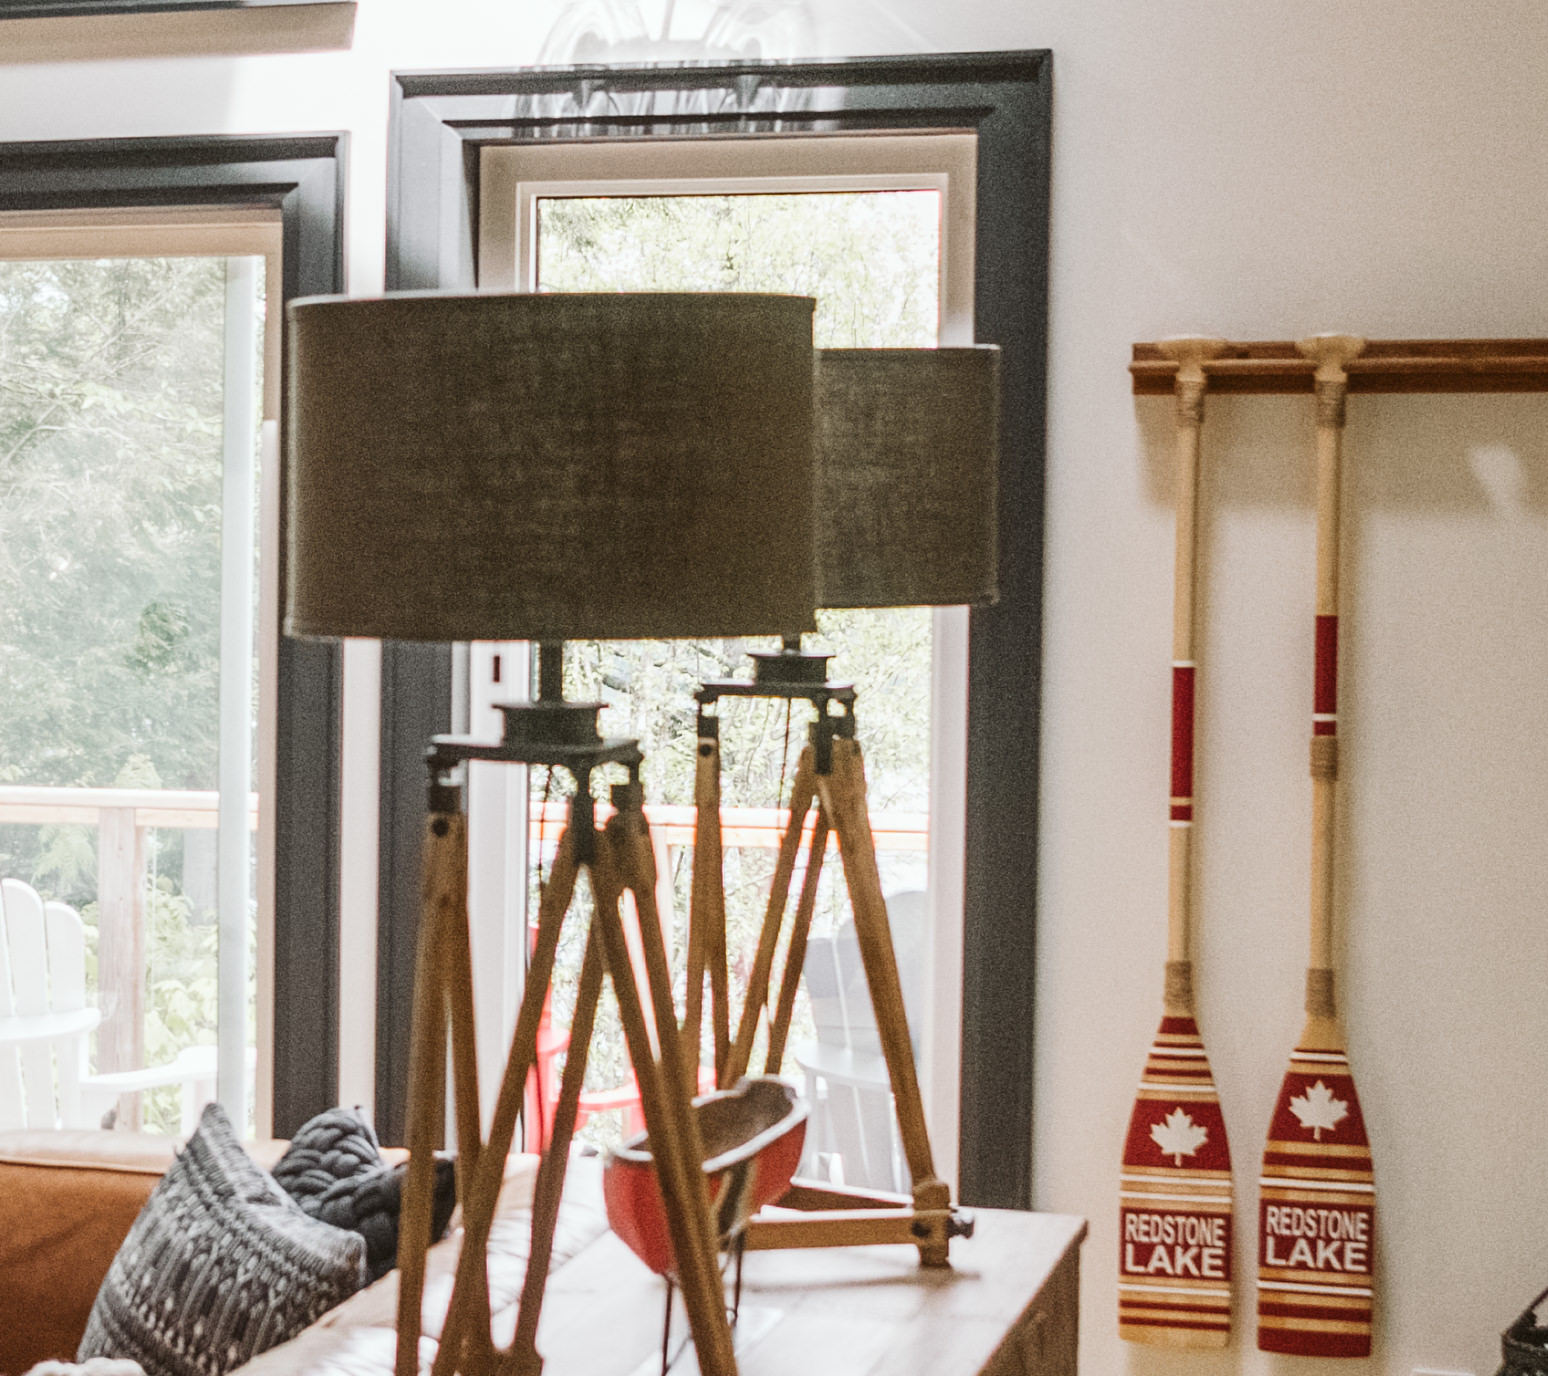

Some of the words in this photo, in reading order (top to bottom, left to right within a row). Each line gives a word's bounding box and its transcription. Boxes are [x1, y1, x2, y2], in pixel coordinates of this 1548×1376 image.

[1125, 1212, 1226, 1247] REDSTONE
[1266, 1205, 1369, 1241] REDSTONE
[1125, 1243, 1225, 1278] LAKE
[1266, 1236, 1368, 1272] LAKE
